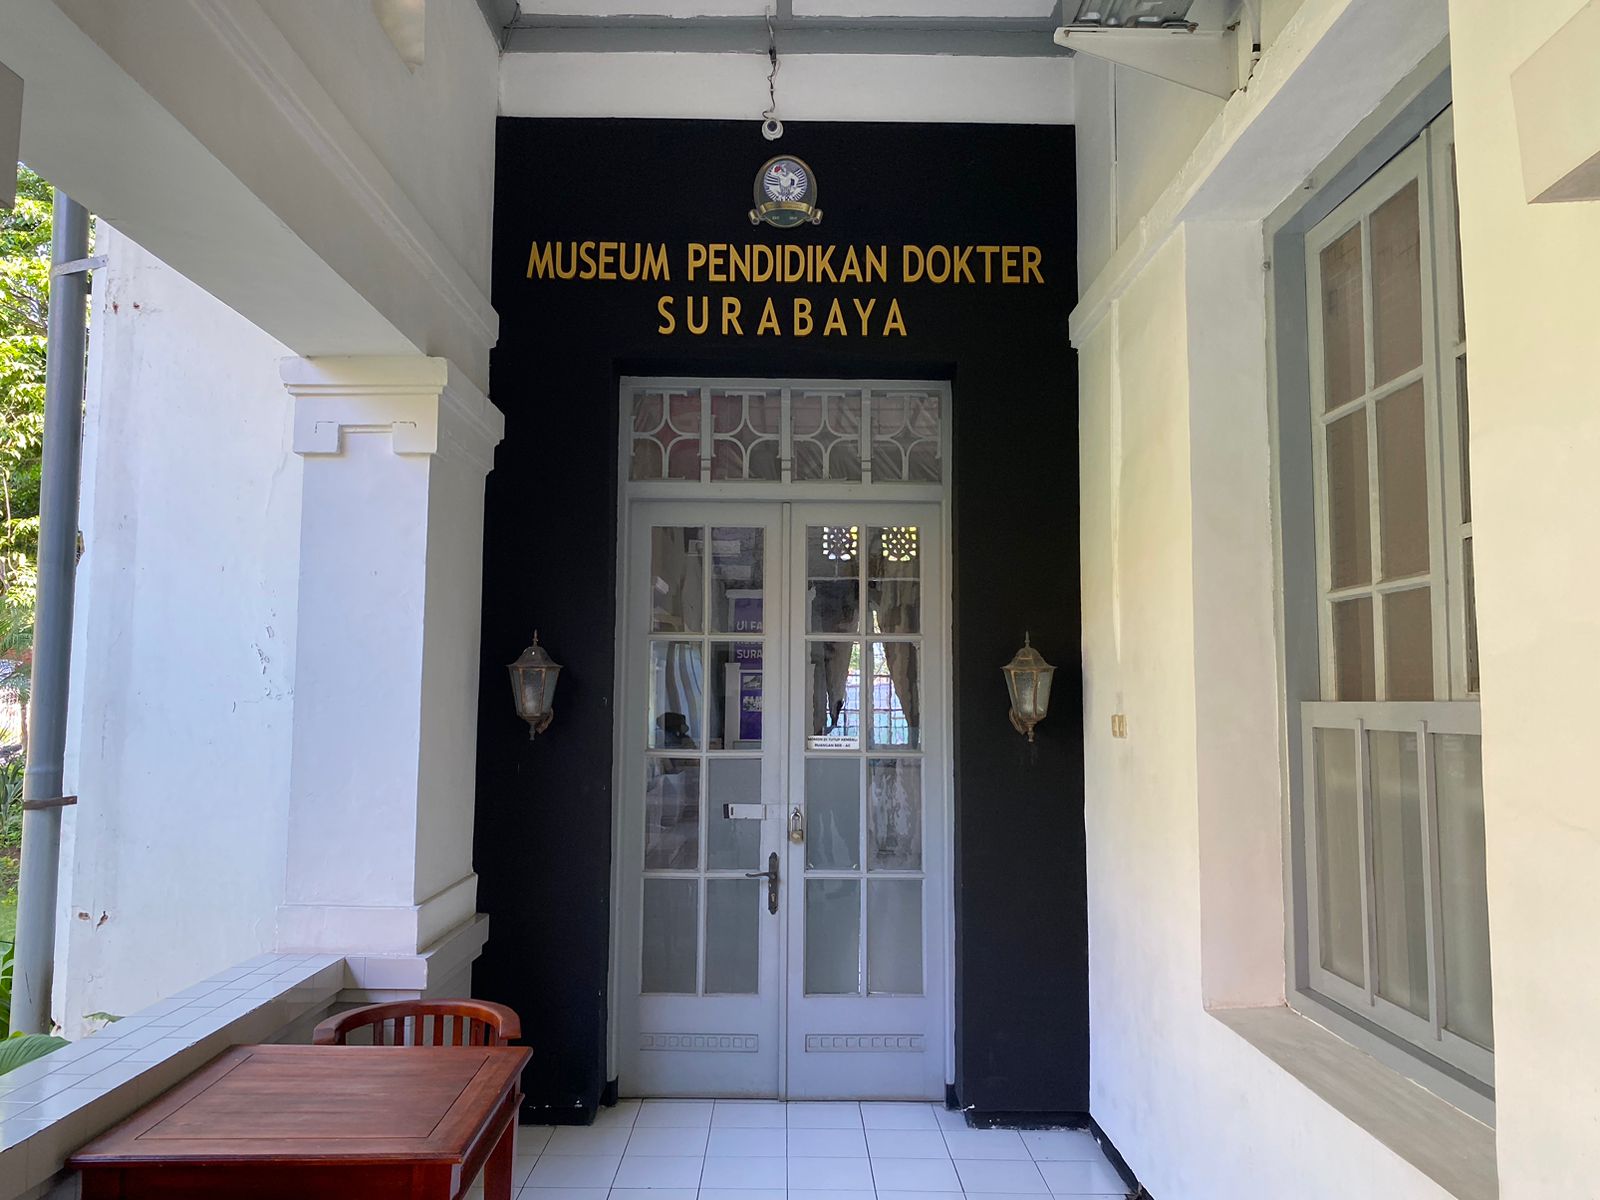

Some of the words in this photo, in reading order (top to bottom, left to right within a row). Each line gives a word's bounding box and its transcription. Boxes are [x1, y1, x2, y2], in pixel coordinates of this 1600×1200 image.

[526, 241, 671, 282] MUSEUM
[687, 242, 888, 284] PENDIDIKAN
[902, 244, 1046, 285] DOKTER
[657, 295, 908, 337] SURABAYA
